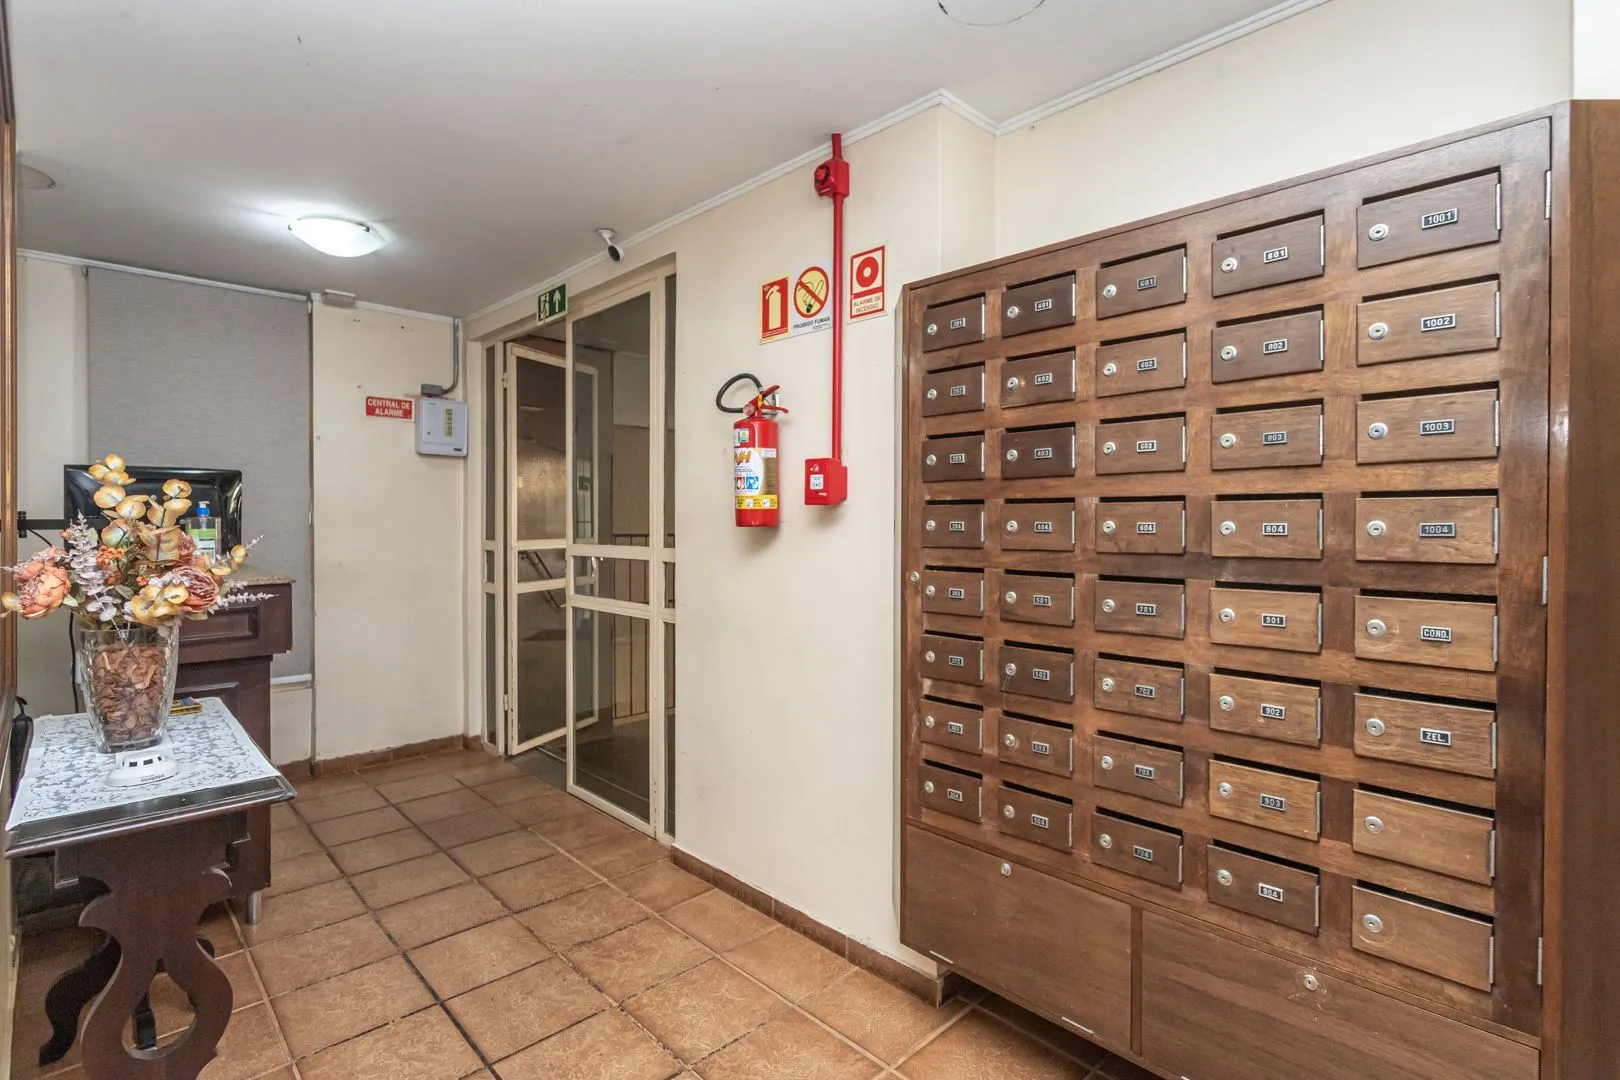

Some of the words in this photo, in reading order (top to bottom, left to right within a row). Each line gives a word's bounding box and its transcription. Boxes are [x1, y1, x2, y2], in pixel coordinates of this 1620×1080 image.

[1427, 212, 1452, 224] 1001
[1268, 250, 1285, 260] 801
[1140, 277, 1154, 287] 601
[1038, 301, 1049, 309] 401
[793, 321, 813, 329] PROIBIDO
[815, 316, 830, 324] FUMAR
[1426, 317, 1450, 327] 1002
[1268, 342, 1283, 350] 802
[368, 398, 399, 408] CENTRAL
[375, 408, 403, 417] ALARME
[1425, 423, 1449, 431] 1003
[1268, 434, 1282, 442] 803
[1266, 525, 1283, 533] 804
[1265, 616, 1281, 624] 901
[1424, 629, 1449, 639] COND.
[1266, 708, 1281, 716] 902
[1426, 732, 1445, 742] ZEL.
[1264, 797, 1281, 808] 903
[1262, 887, 1278, 898] 904
